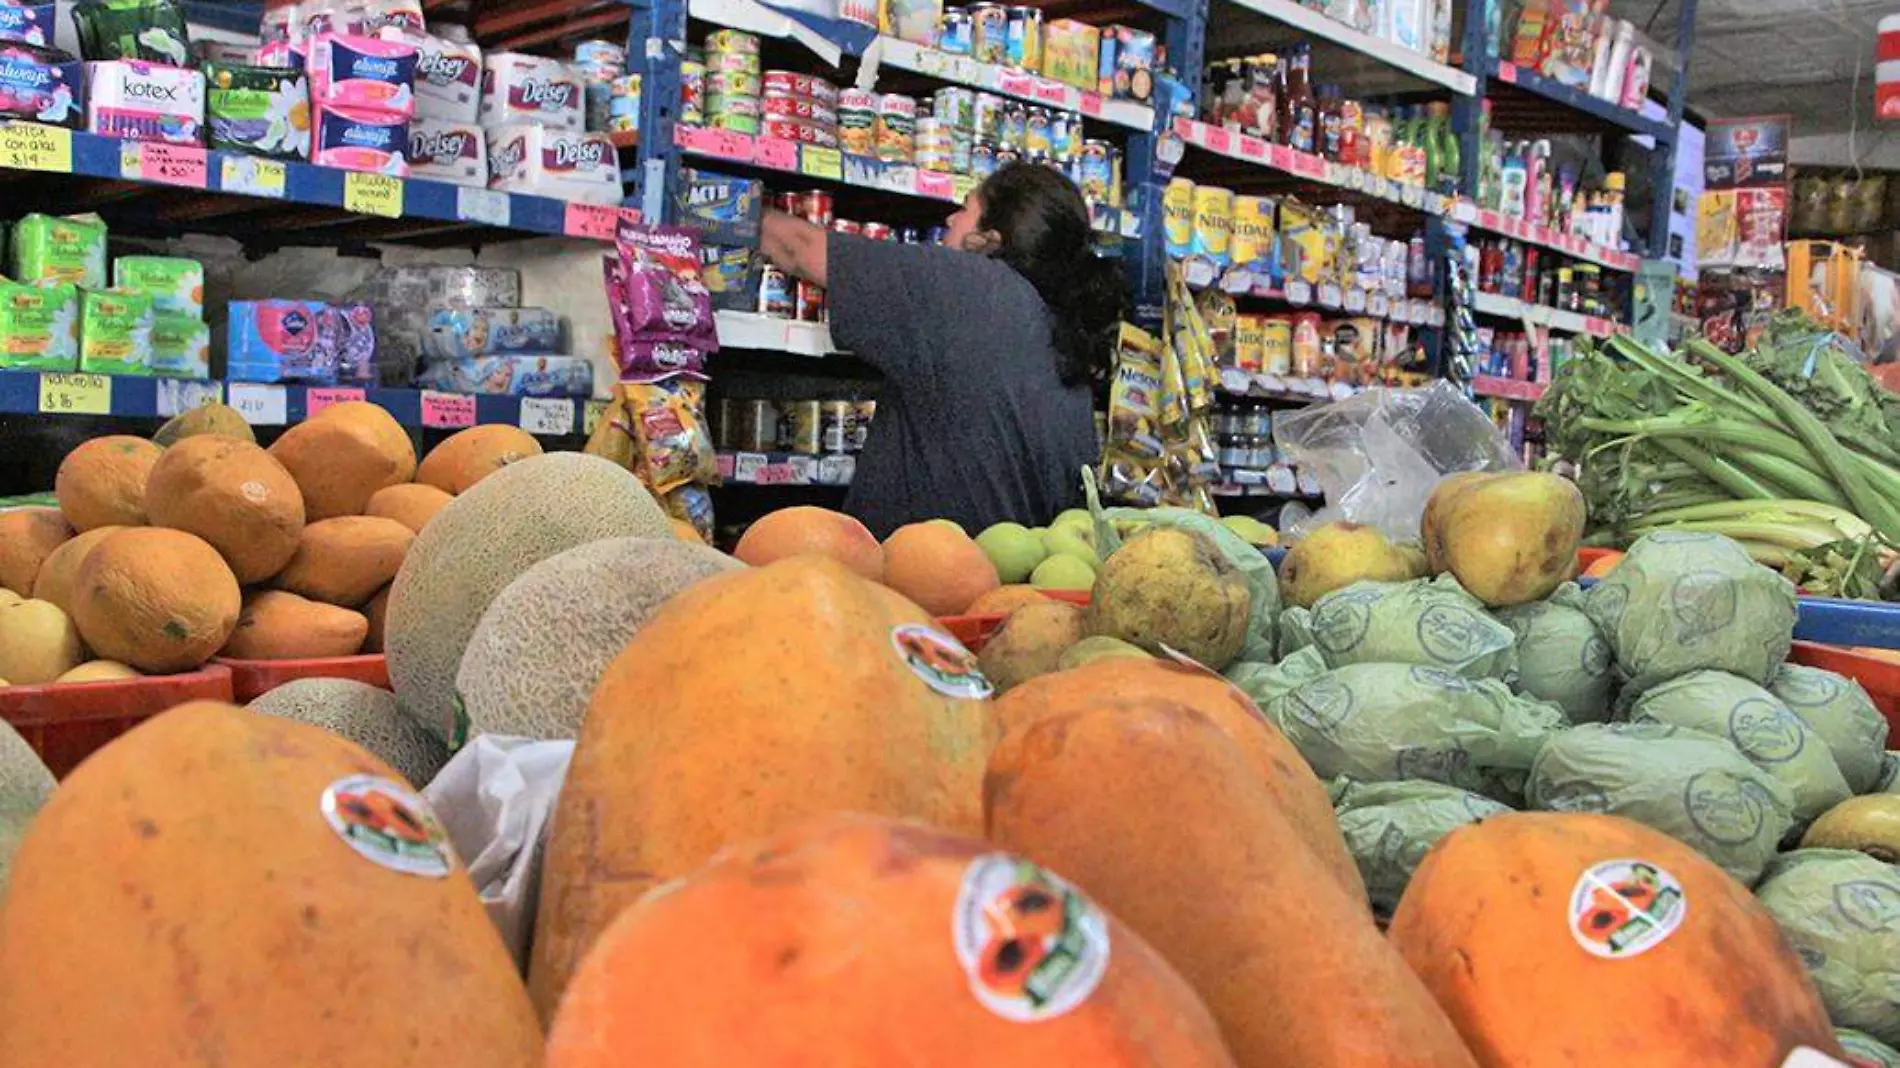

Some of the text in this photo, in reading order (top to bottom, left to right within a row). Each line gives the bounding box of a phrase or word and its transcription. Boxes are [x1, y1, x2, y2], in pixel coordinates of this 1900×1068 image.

[124, 75, 178, 101] kotex
[523, 77, 571, 105] Delsey
[413, 131, 466, 157] Delsey
[556, 139, 603, 165] Delsey
[688, 186, 717, 205] ACT
